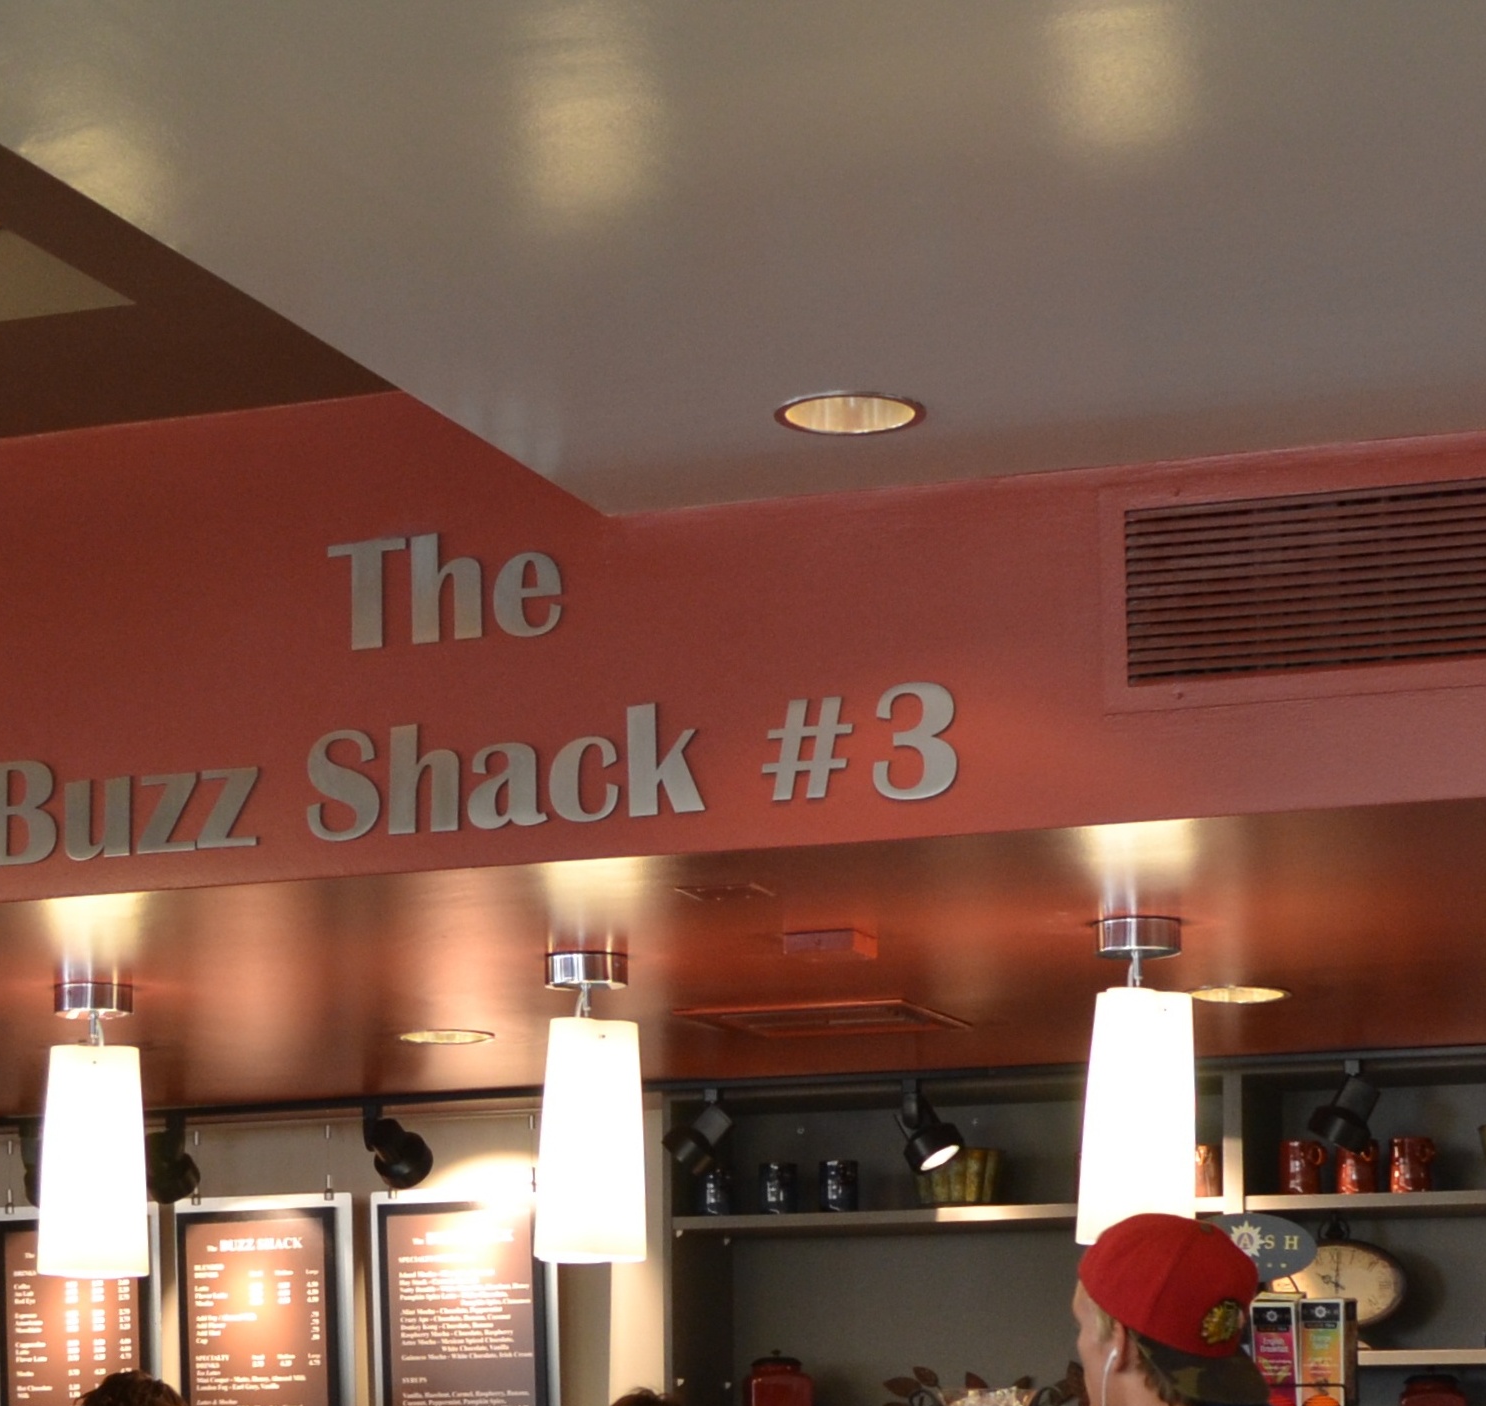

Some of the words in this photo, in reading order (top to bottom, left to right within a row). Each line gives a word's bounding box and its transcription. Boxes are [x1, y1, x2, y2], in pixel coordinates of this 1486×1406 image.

[327, 533, 562, 650] The
[306, 702, 704, 842] Shack
[761, 680, 957, 802] #3
[1237, 1233, 1301, 1252] ASH
